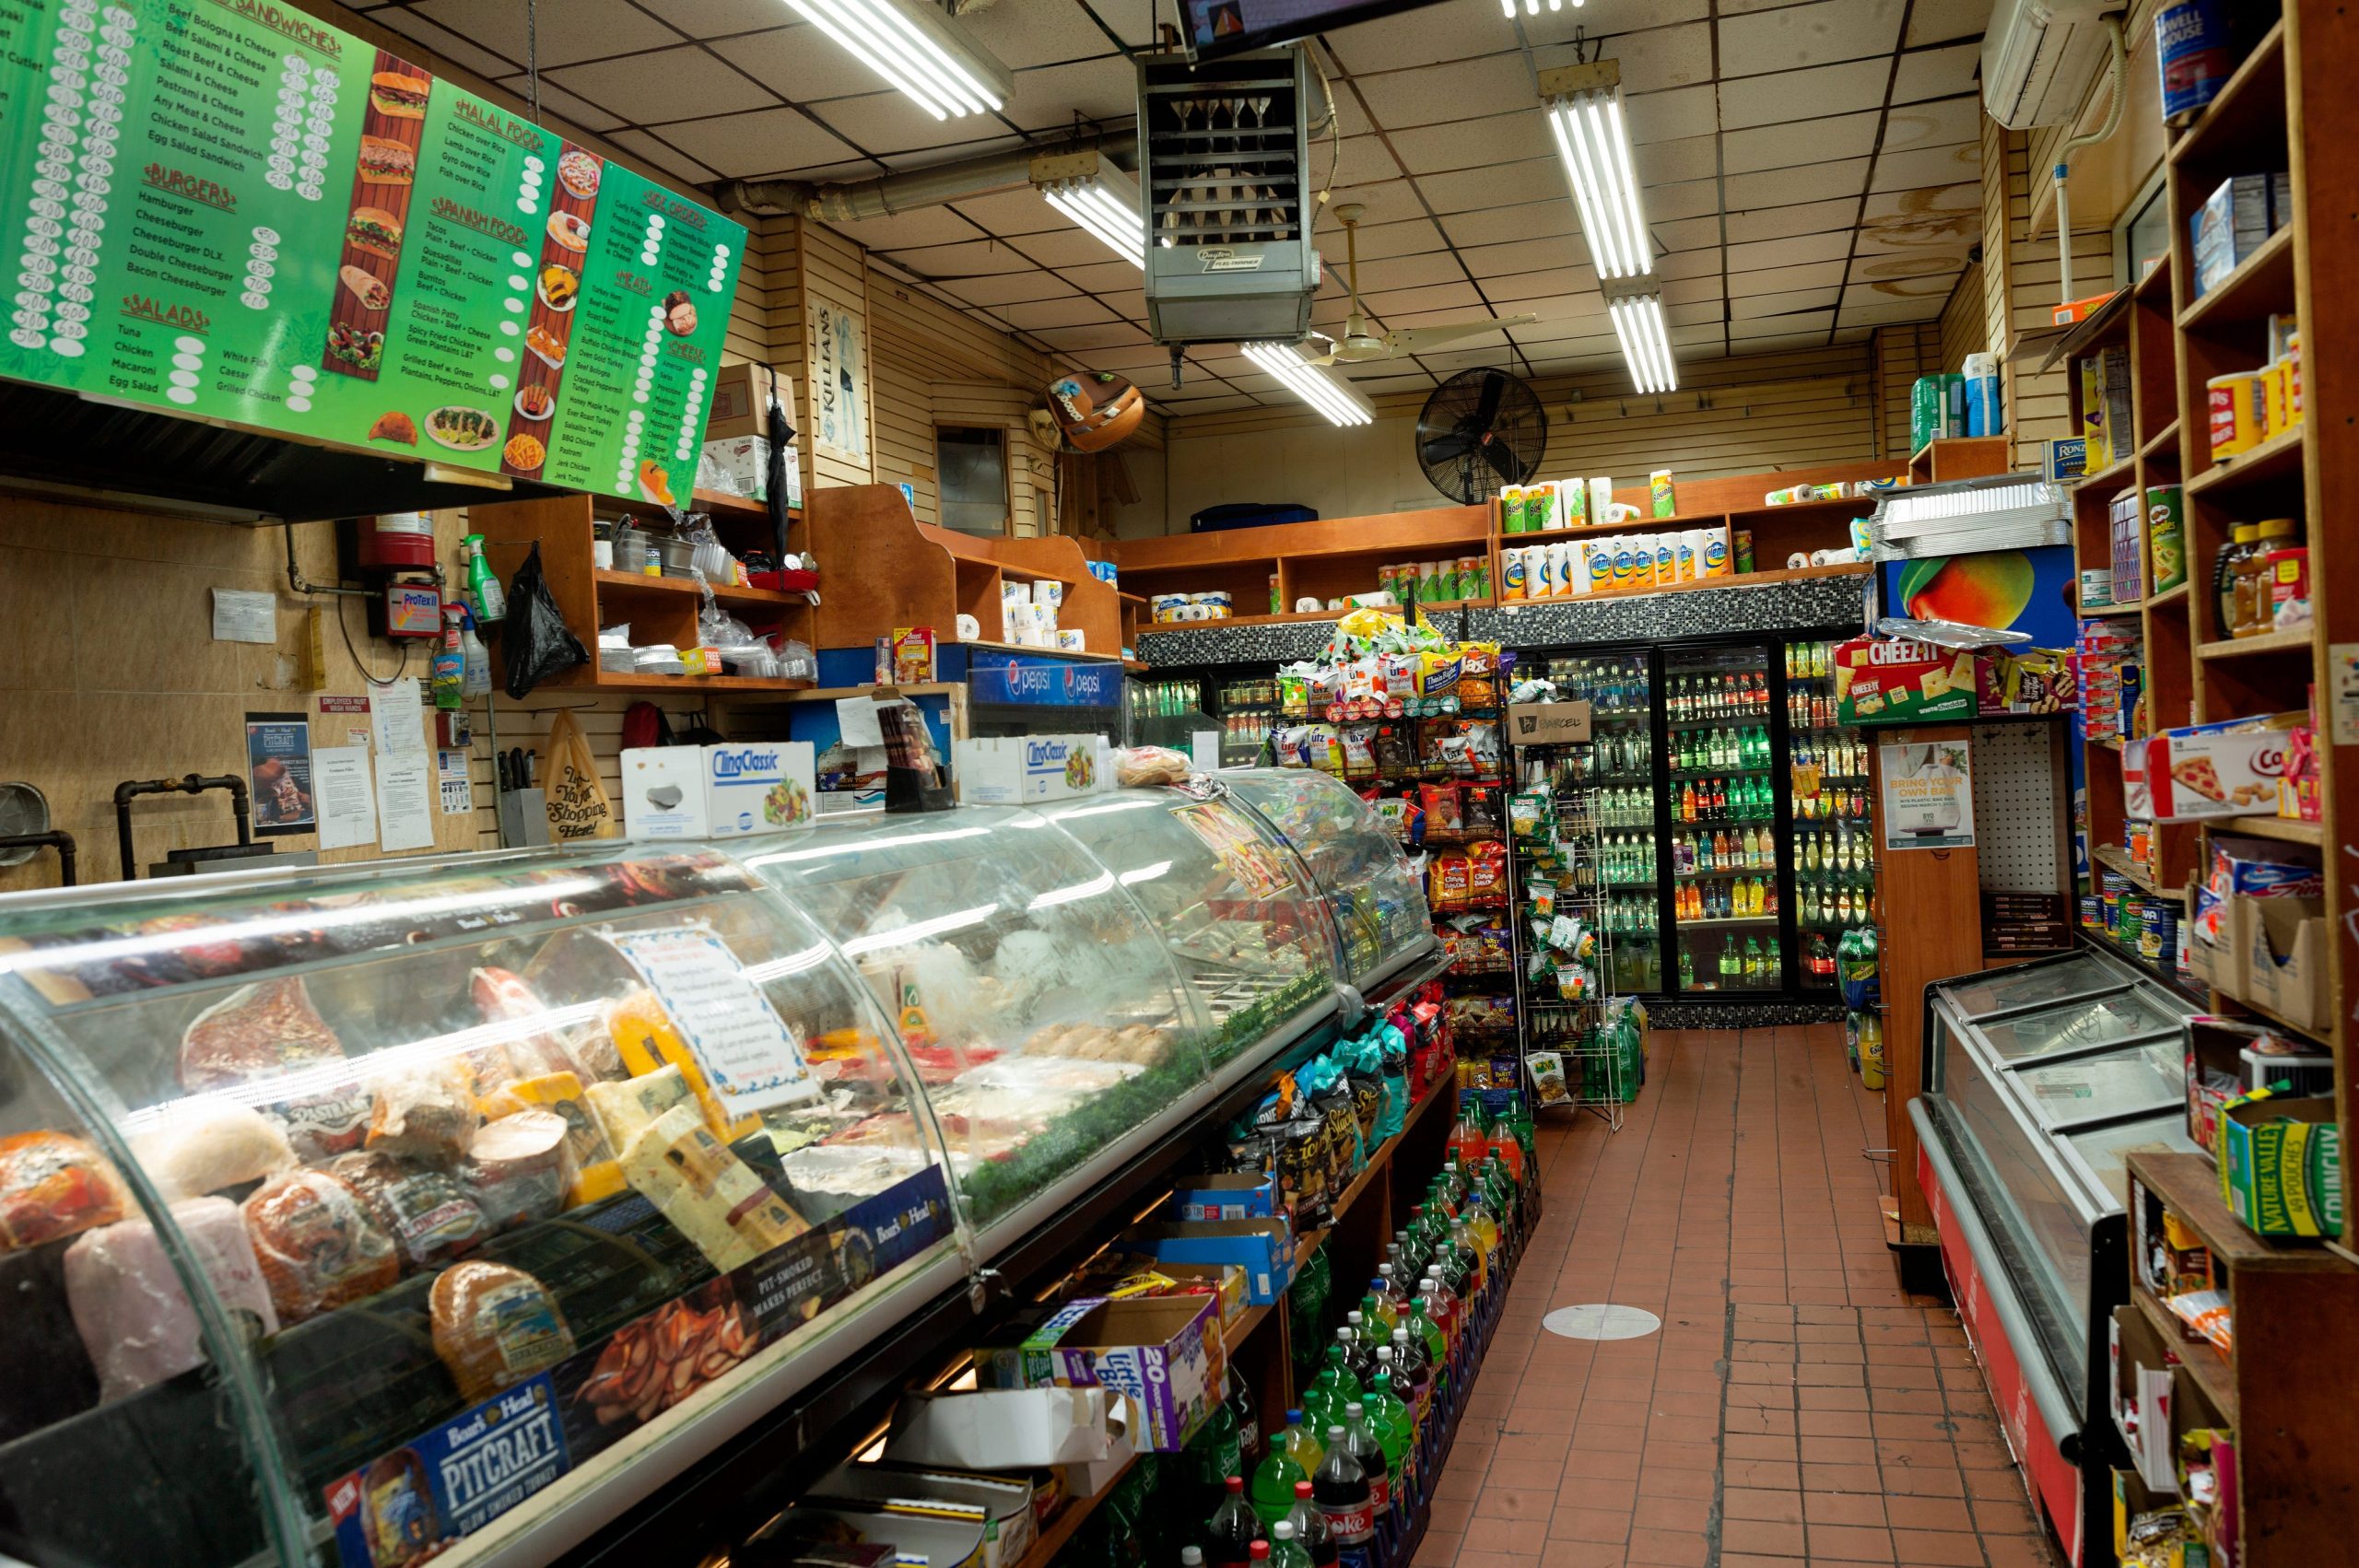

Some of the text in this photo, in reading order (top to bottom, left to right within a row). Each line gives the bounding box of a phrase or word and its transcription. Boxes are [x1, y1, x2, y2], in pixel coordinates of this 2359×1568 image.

[169, 3, 276, 59] Beef Bologna & Cheese
[165, 20, 266, 73] Beef Salami & Cheese
[159, 57, 239, 96] Salami & Cheese
[162, 40, 260, 88] Roast Beef & Cheese
[157, 76, 244, 117] Pastrami & Cheese
[154, 94, 245, 136] Any Meat & Cheese
[461, 99, 539, 146] HALAL FOOD
[150, 111, 264, 161] Chicken Salad Sandwich
[447, 123, 506, 155] Chicken over Rice
[147, 130, 244, 171] Egg Salad Sandwich
[444, 138, 496, 165] Lamb over Rice
[441, 153, 491, 178] Gyro over Rice
[148, 163, 229, 204] BURGERS
[440, 167, 487, 192] Fish over Rice
[138, 192, 194, 217] Hamburger
[135, 209, 204, 239] Cheeseburger
[428, 222, 447, 234] Tacos
[437, 198, 524, 242] SPANISH FOOD
[133, 228, 200, 256] Cheeseburger
[130, 245, 233, 283] Double Cheeseburger
[423, 247, 463, 265] Quesadillas
[1201, 251, 1231, 260] Dayton
[126, 263, 227, 298] Bacon Cheeseburger
[417, 281, 467, 302] Beef Chicken
[418, 271, 446, 286] Burritos
[131, 294, 204, 327] SALADS
[413, 300, 459, 321] Spanish Patty
[118, 324, 141, 338] Tuna
[114, 342, 154, 358] Chicken
[111, 358, 157, 376] Macaroni
[109, 376, 158, 393] Egg Salad
[559, 447, 582, 458] Pastrami
[562, 434, 595, 448] BBQ Chicken
[555, 473, 585, 485] Jerk Turkey
[557, 460, 591, 472] Jerk Chicken
[1653, 487, 1673, 501] Bounty
[706, 650, 720, 661] FREE
[902, 638, 925, 647] Jemima
[1022, 667, 1051, 695] pepsi
[1076, 673, 1100, 696] pepsi
[1442, 666, 1457, 678] Right
[2023, 676, 2031, 700] Fudge
[2031, 675, 2039, 701] Stripes
[1539, 718, 1579, 730] BARCEL
[264, 736, 295, 746] PITCRAFT
[1027, 741, 1067, 766] ClingClassic
[713, 750, 778, 777] ClingClassic
[1891, 778, 1962, 789] BRING YOUR
[1931, 787, 1954, 795] BAG
[546, 802, 607, 822] Shopping
[559, 822, 597, 837] Here!
[2258, 1123, 2289, 1231] NATURE VALLEY
[2284, 1141, 2304, 1196] POUCHES
[875, 1199, 931, 1246] Boar's Head
[757, 1255, 815, 1295] PIT-SMOKED
[754, 1289, 785, 1316] MAKES
[1106, 1354, 1143, 1399] Little
[1144, 1348, 1168, 1449] 20 POUCH VALUE PACK
[447, 1387, 534, 1449] Boar's Head
[440, 1411, 558, 1511] PITCRAFT
[330, 1480, 358, 1515] NEW
[487, 1489, 524, 1523] SMOKED
[525, 1465, 557, 1497] TURKEY
